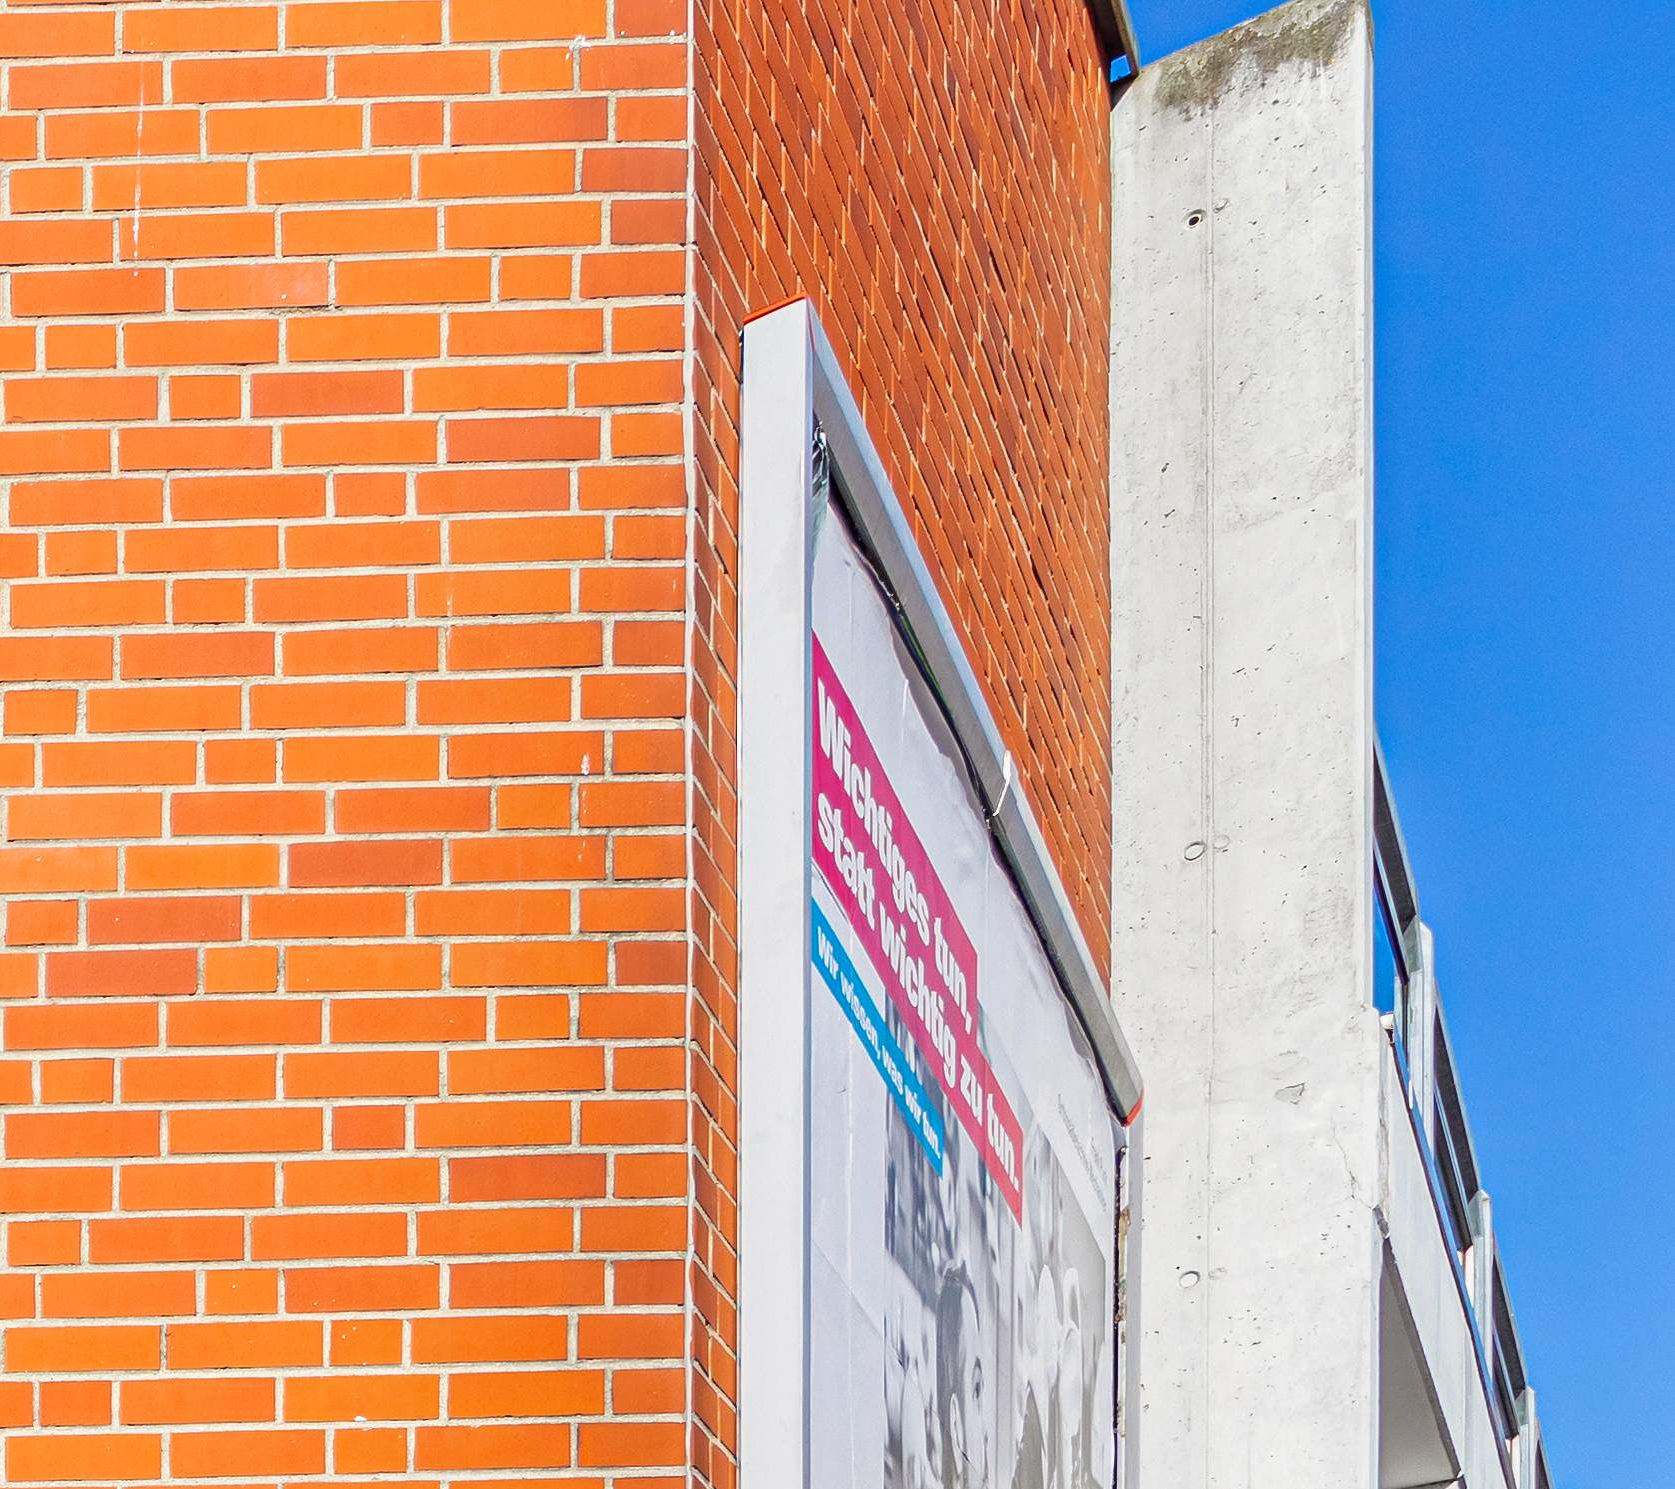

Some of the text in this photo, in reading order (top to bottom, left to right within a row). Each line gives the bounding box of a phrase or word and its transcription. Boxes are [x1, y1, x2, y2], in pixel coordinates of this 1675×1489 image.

[818, 677, 972, 1034] Wichtiges tun,
[818, 792, 1019, 1193] statt wichtig zu tun.
[817, 925, 941, 1161] Wir wissen, was wir tun.
